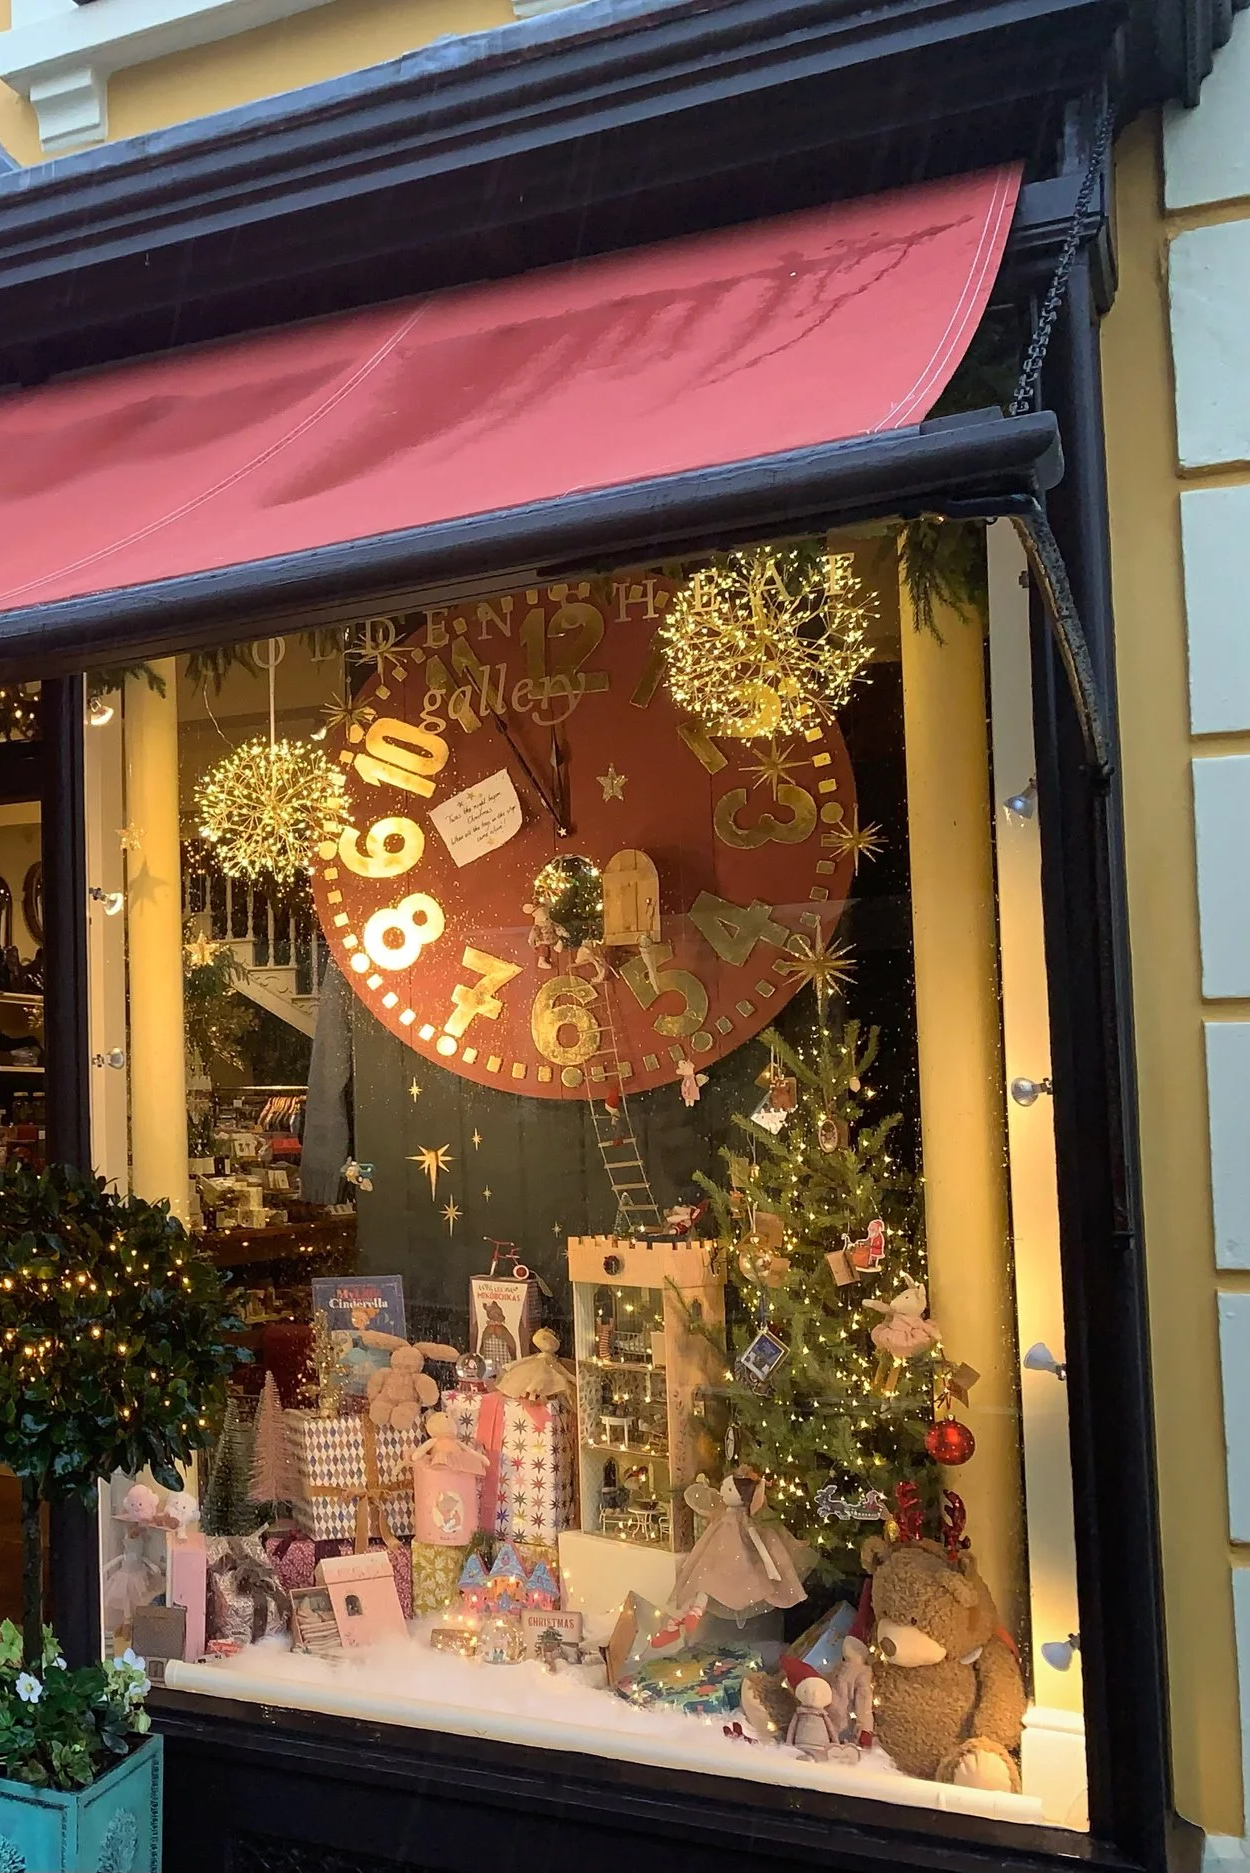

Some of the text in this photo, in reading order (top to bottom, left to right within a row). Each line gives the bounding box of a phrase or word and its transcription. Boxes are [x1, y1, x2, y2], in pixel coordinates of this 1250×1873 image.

[519, 603, 610, 699] 12
[418, 663, 586, 736] gallery
[352, 717, 449, 798] 10
[338, 817, 425, 878] 9
[714, 784, 817, 849] 3
[363, 893, 446, 971] 8
[687, 889, 790, 967] 4
[444, 946, 524, 1038] 7
[531, 975, 601, 1066] 6
[618, 942, 708, 1037] 5
[328, 1297, 388, 1309] Cinderella
[528, 1616, 575, 1629] CHRISTMAS
